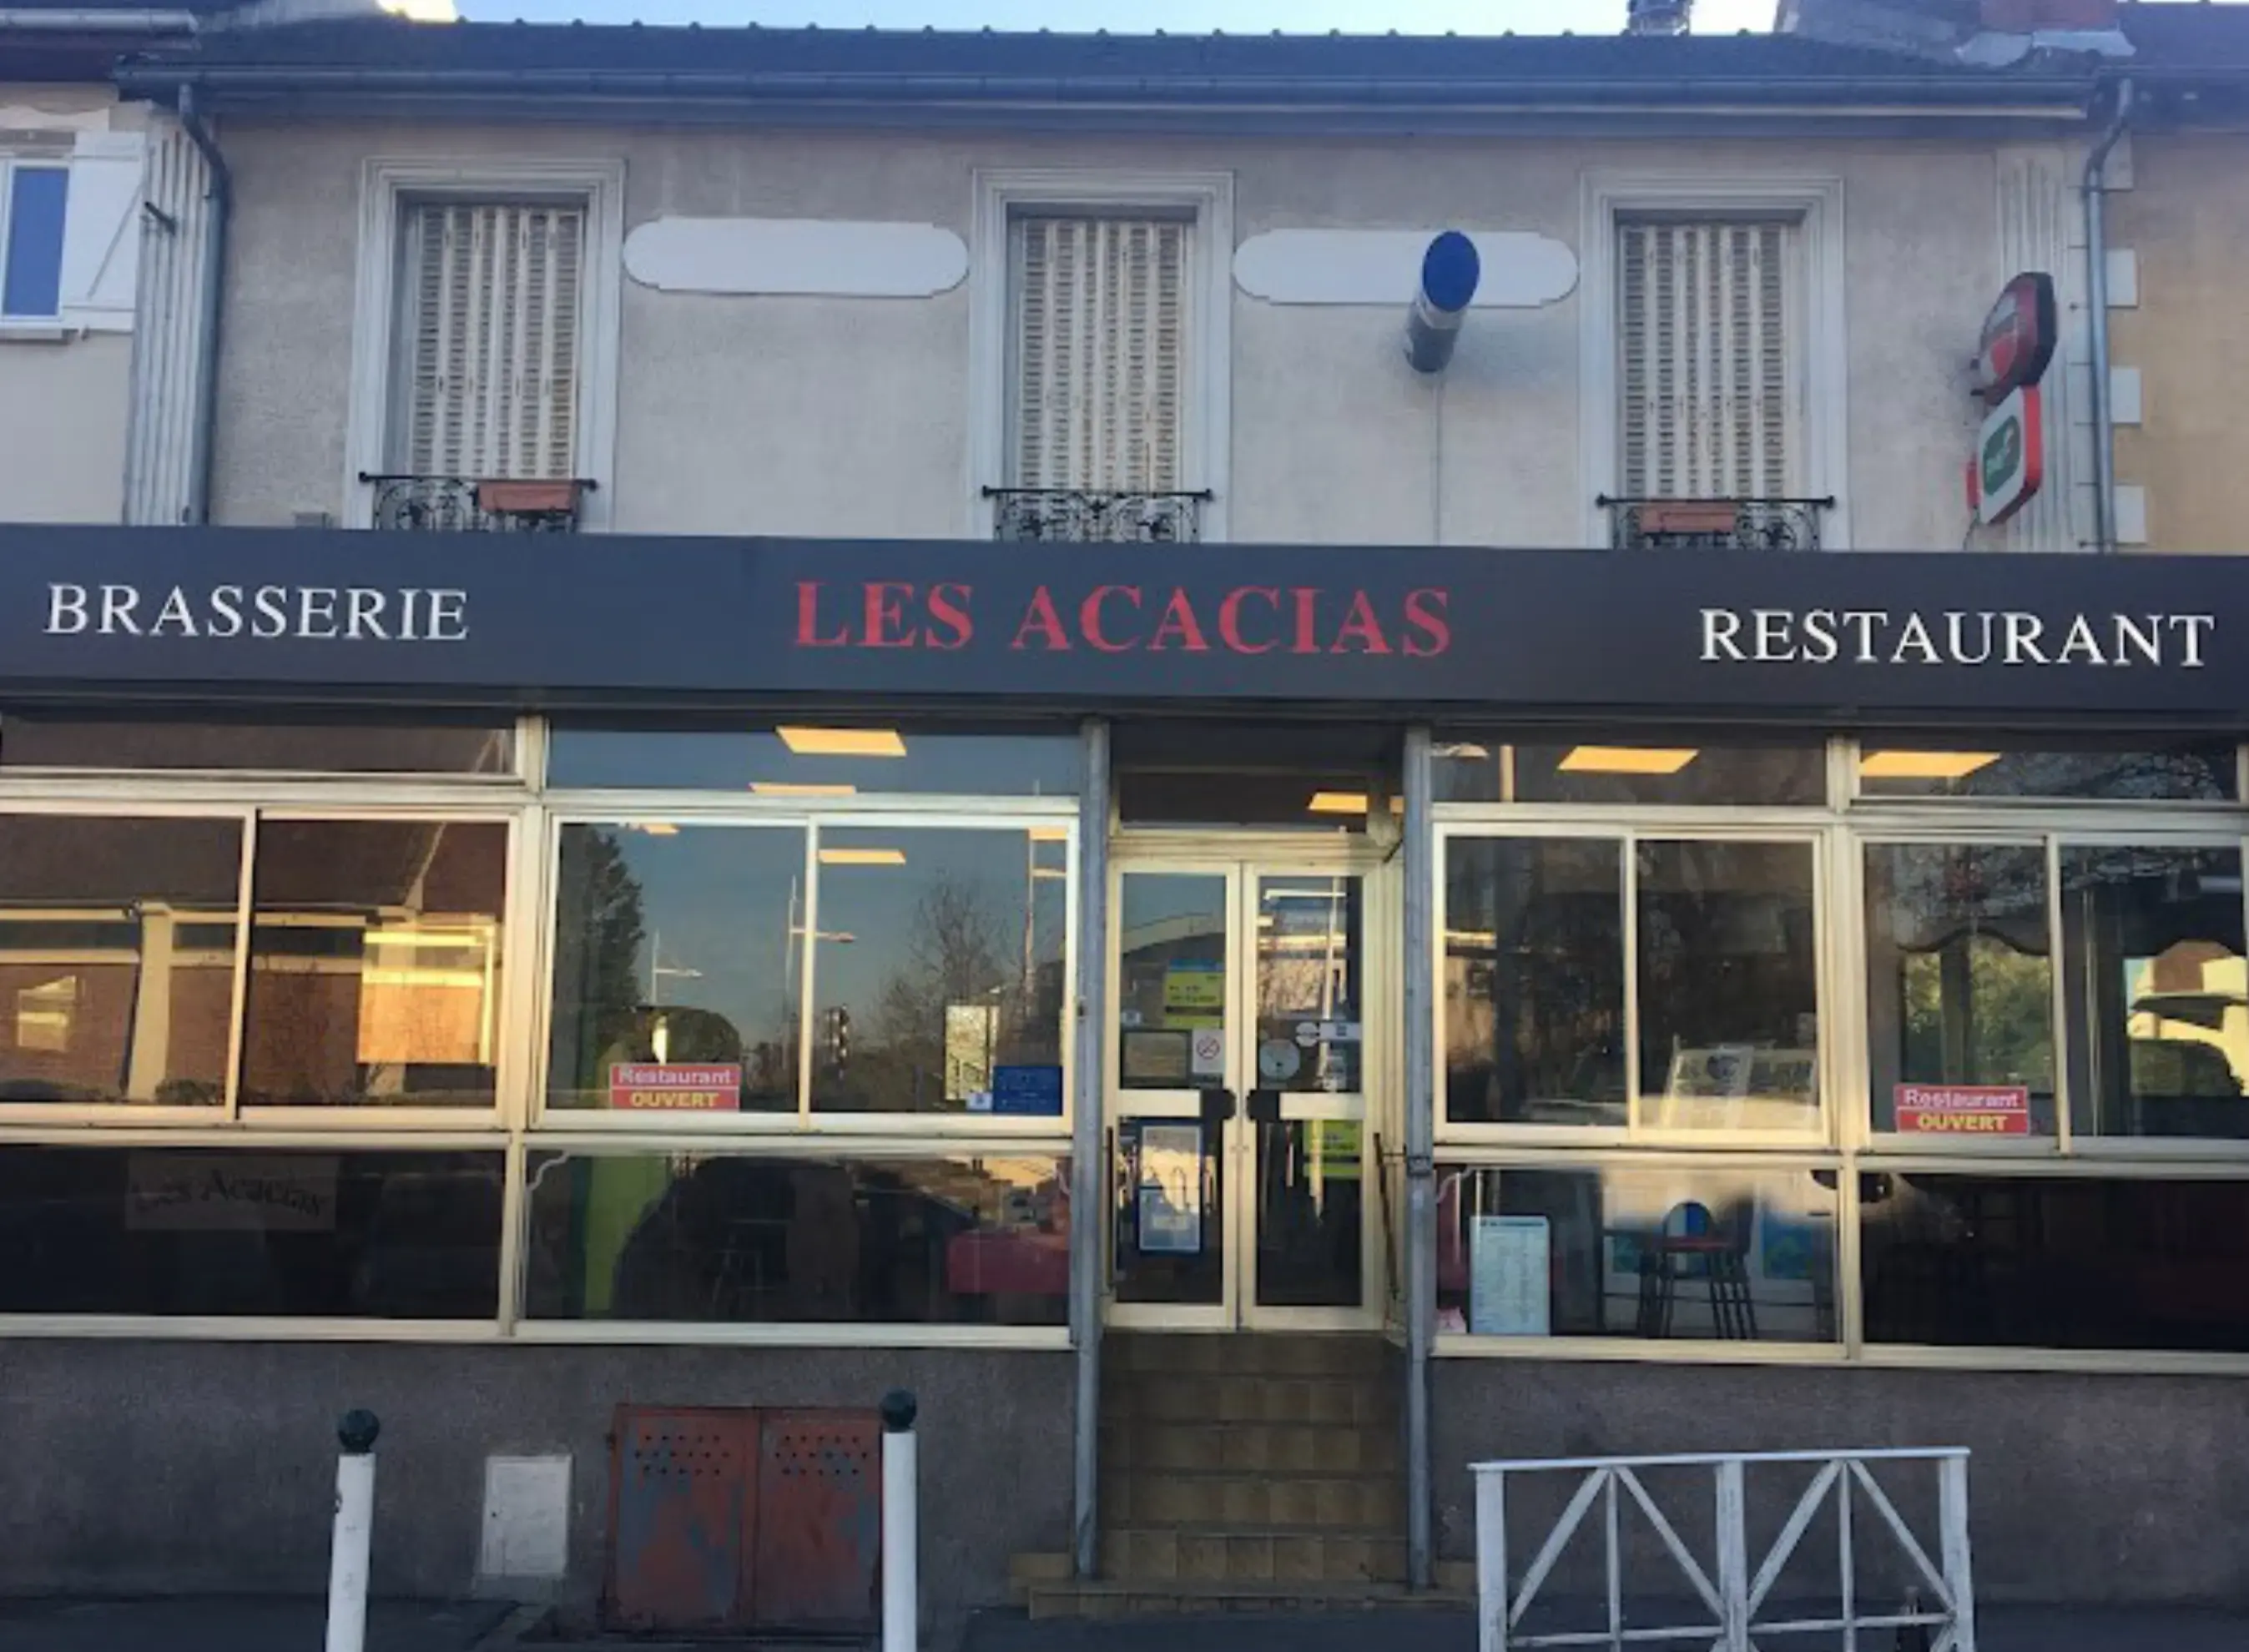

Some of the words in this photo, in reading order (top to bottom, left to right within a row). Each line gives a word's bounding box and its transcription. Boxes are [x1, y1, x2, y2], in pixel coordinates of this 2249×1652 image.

[43, 583, 470, 641] BRASSERIE
[795, 581, 975, 650] LES
[1010, 585, 1451, 657] ACACIAS
[1699, 608, 2216, 667] RESTAURANT
[618, 1066, 732, 1084] Restaurant
[630, 1091, 720, 1108] OUVERT
[1904, 1089, 2019, 1108] Restaurant
[1917, 1113, 2009, 1131] OUVERT
